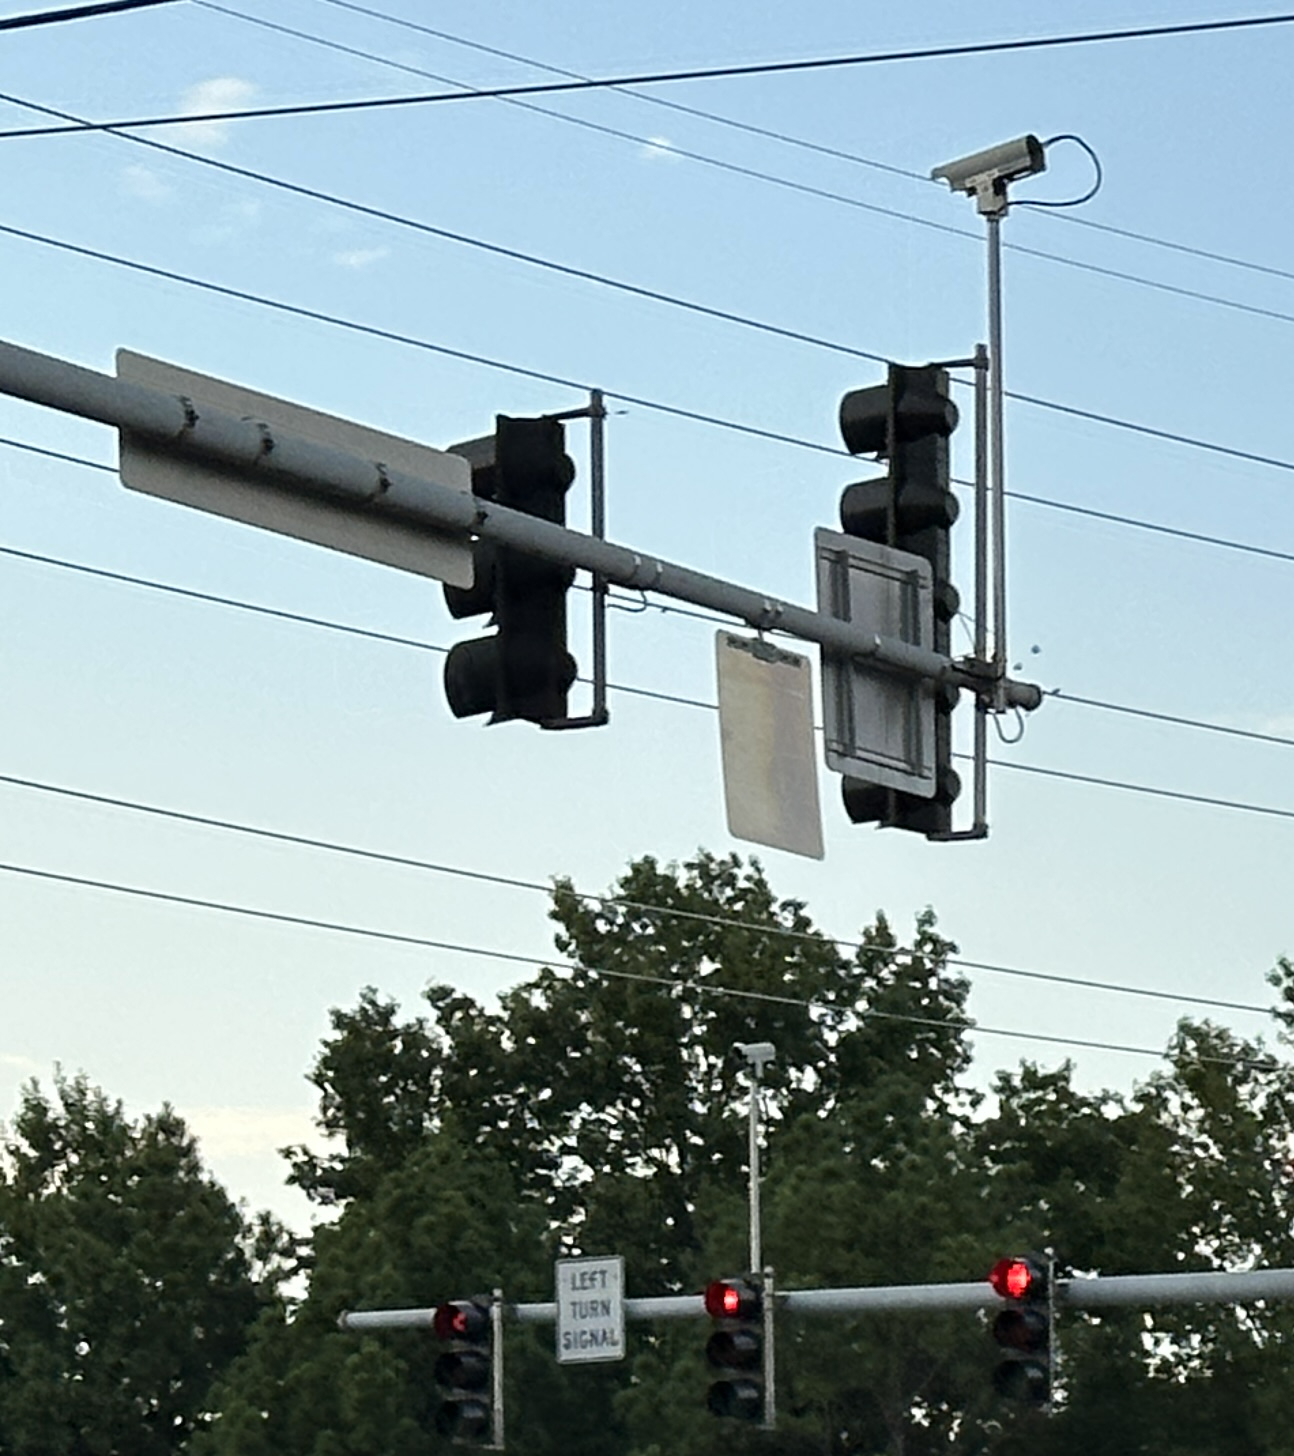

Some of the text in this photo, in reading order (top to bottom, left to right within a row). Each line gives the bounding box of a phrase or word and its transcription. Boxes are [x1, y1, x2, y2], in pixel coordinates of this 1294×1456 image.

[571, 1270, 607, 1291] LEFT
[570, 1300, 611, 1320] TURN
[563, 1328, 619, 1350] SIGNAL
